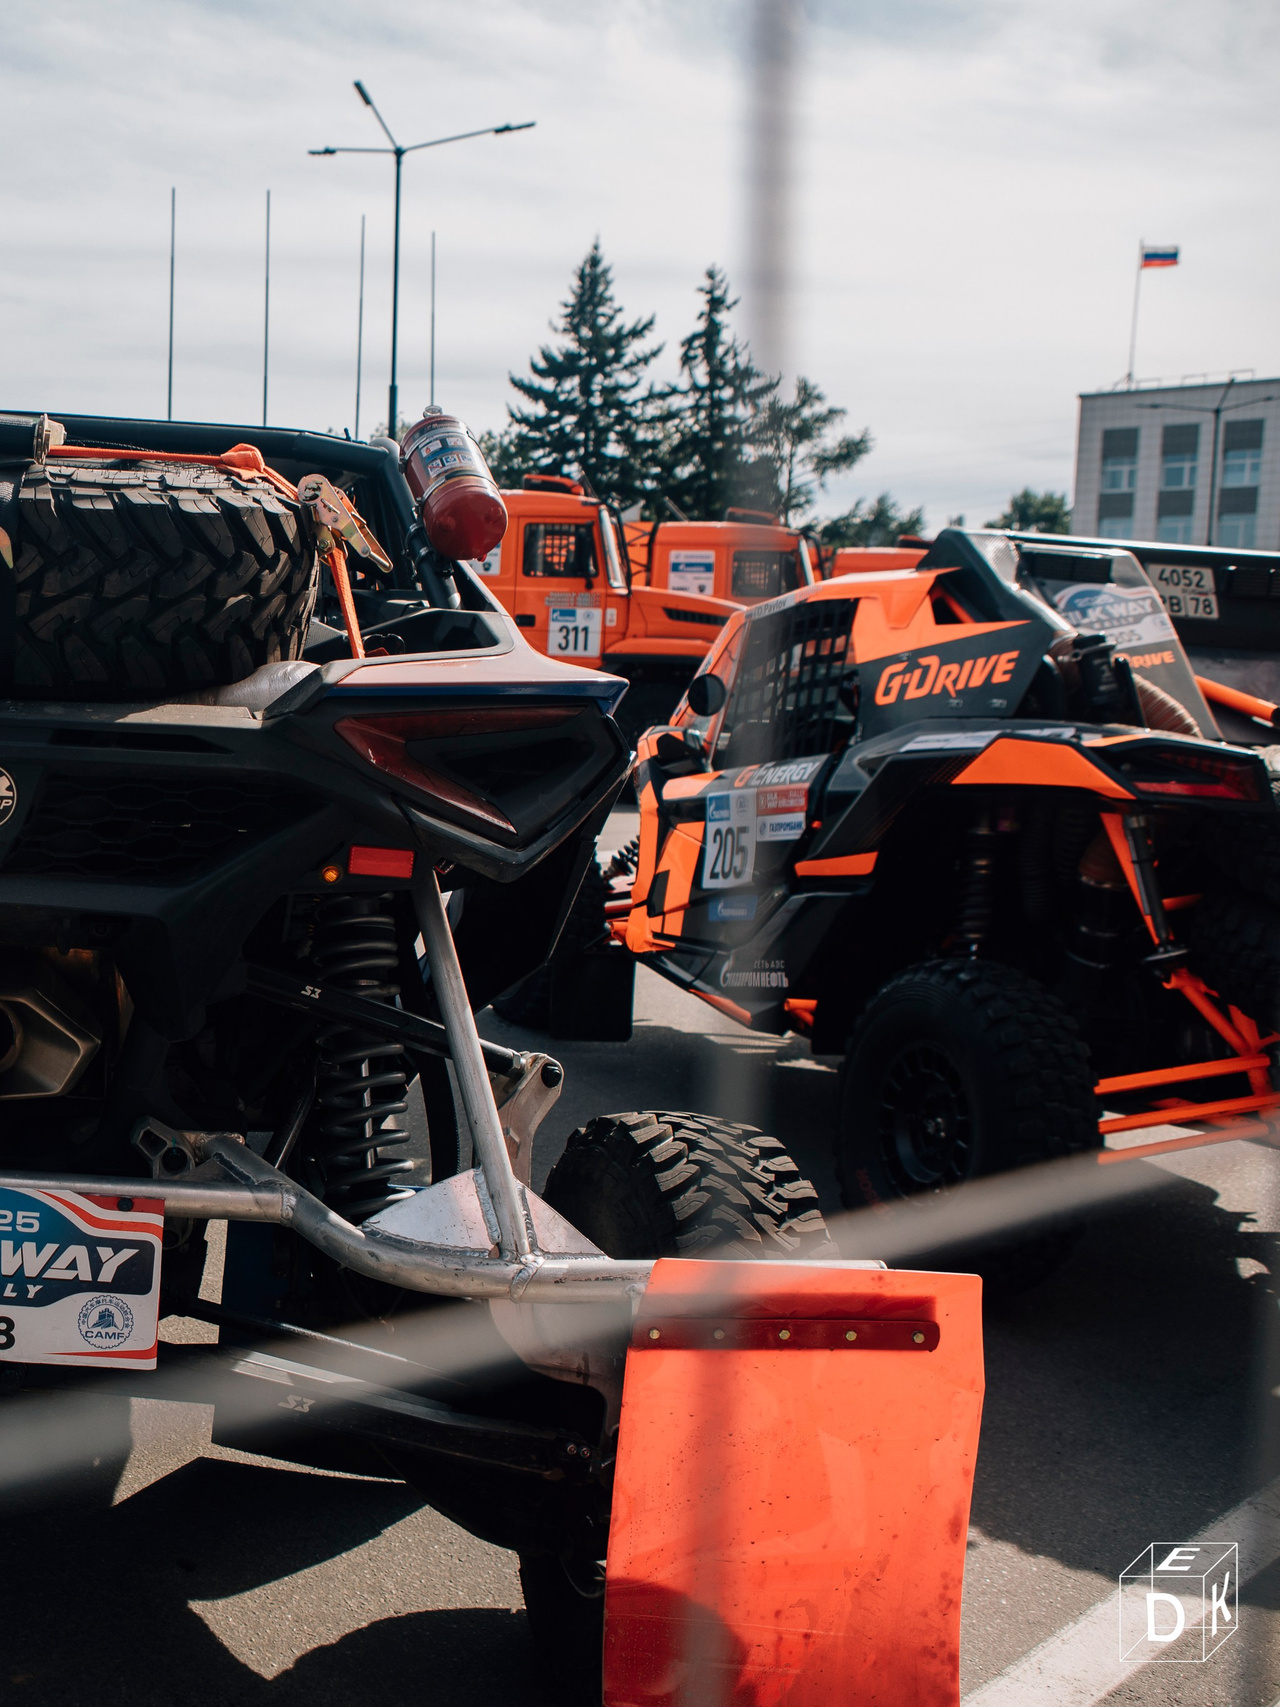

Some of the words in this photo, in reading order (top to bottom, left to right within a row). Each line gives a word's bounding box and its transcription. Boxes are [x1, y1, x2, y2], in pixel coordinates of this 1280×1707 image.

[1159, 568, 1206, 588] 4052
[1106, 598, 1153, 619] WAY
[1190, 597, 1214, 615] 78
[558, 624, 590, 652] 311
[709, 825, 750, 880] 205
[0, 1239, 140, 1283] WAY
[84, 1330, 125, 1341] CAMF
